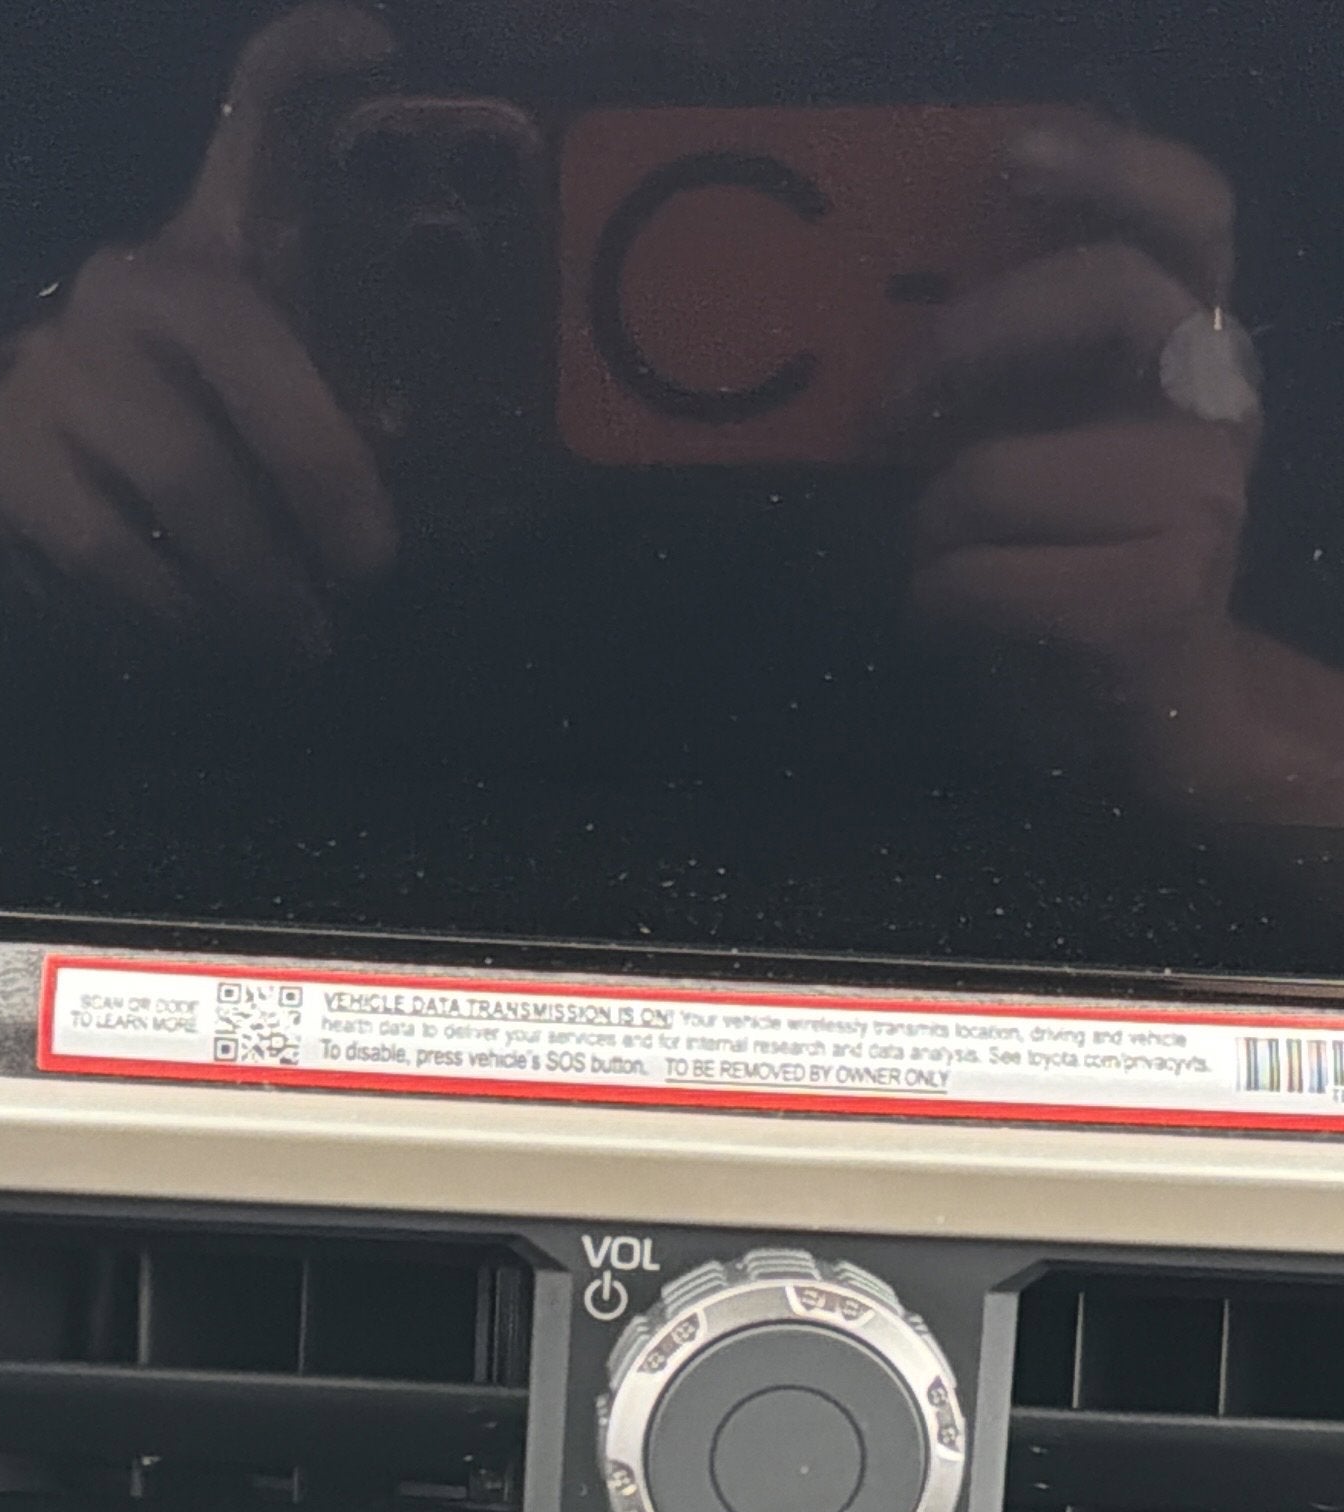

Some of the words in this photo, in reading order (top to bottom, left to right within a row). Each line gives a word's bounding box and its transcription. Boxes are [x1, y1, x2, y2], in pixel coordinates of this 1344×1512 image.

[70, 1010, 93, 1027] TO
[96, 1012, 148, 1030] LEARN
[152, 1015, 199, 1033] MORE
[320, 1015, 373, 1033] health
[379, 1018, 415, 1036] data
[421, 1020, 438, 1038] to
[443, 1023, 500, 1041] deliver
[505, 1029, 542, 1047] your
[548, 1029, 617, 1047] services
[622, 1032, 653, 1049] and
[658, 1032, 680, 1050] for
[686, 1035, 749, 1054] internal
[753, 1038, 826, 1056] research
[832, 1041, 863, 1058] and
[868, 1042, 905, 1060] data
[988, 1046, 1022, 1065] See
[324, 992, 404, 1014] VEHICLE
[412, 996, 461, 1016] DATA
[466, 999, 612, 1024] TRANSMISSION
[618, 1007, 634, 1024] IS
[680, 1010, 717, 1028] Your
[723, 1013, 781, 1030] vehicle
[1029, 1025, 1086, 1048] driving
[1093, 1030, 1123, 1046] and
[1128, 1031, 1188, 1048] vehicle
[320, 1038, 342, 1060] To
[345, 1041, 411, 1066] disable,
[415, 1047, 463, 1068] press
[468, 1049, 541, 1070] vehicle's
[545, 1051, 586, 1073] SOS
[590, 1055, 650, 1076] button.
[665, 1057, 689, 1077] TO
[692, 1059, 715, 1078] BE
[719, 1061, 806, 1082] REMOVED
[809, 1065, 833, 1083] BY
[836, 1065, 902, 1086] OWNER
[904, 1067, 952, 1088] ONLY
[580, 1235, 661, 1272] VOL
